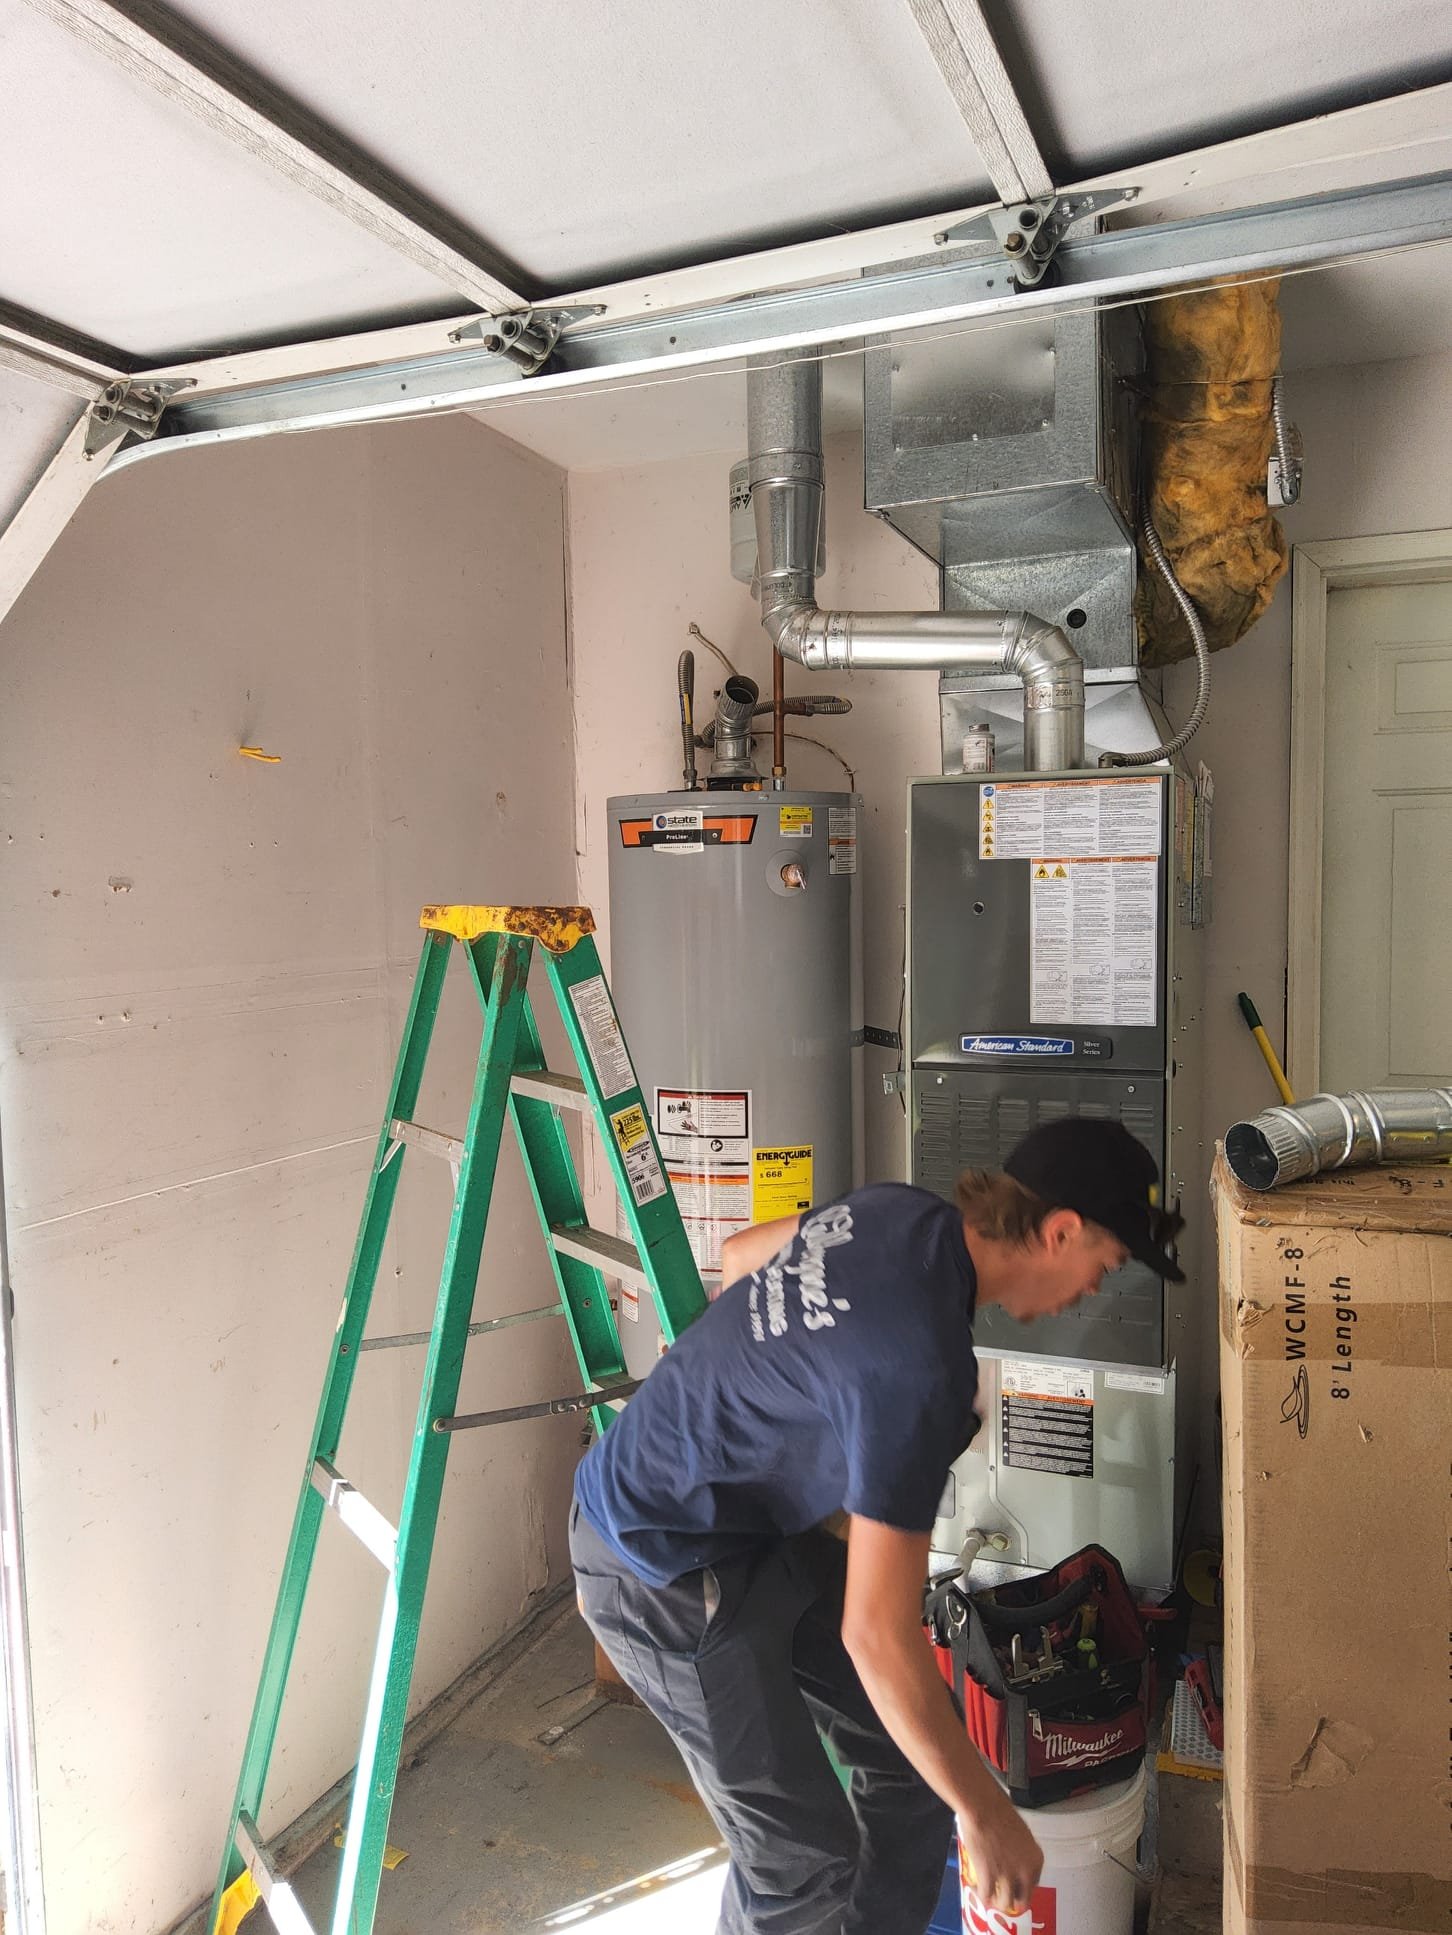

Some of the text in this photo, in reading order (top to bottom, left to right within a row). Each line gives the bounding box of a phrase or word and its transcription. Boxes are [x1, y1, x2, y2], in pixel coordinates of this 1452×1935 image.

[667, 816, 698, 824] state
[969, 1038, 1066, 1052] American Standard
[766, 1170, 783, 1178] 668
[1284, 1247, 1306, 1361] WCMF-8
[1329, 1276, 1357, 1372] Length
[1041, 1729, 1125, 1760] Milwaukee
